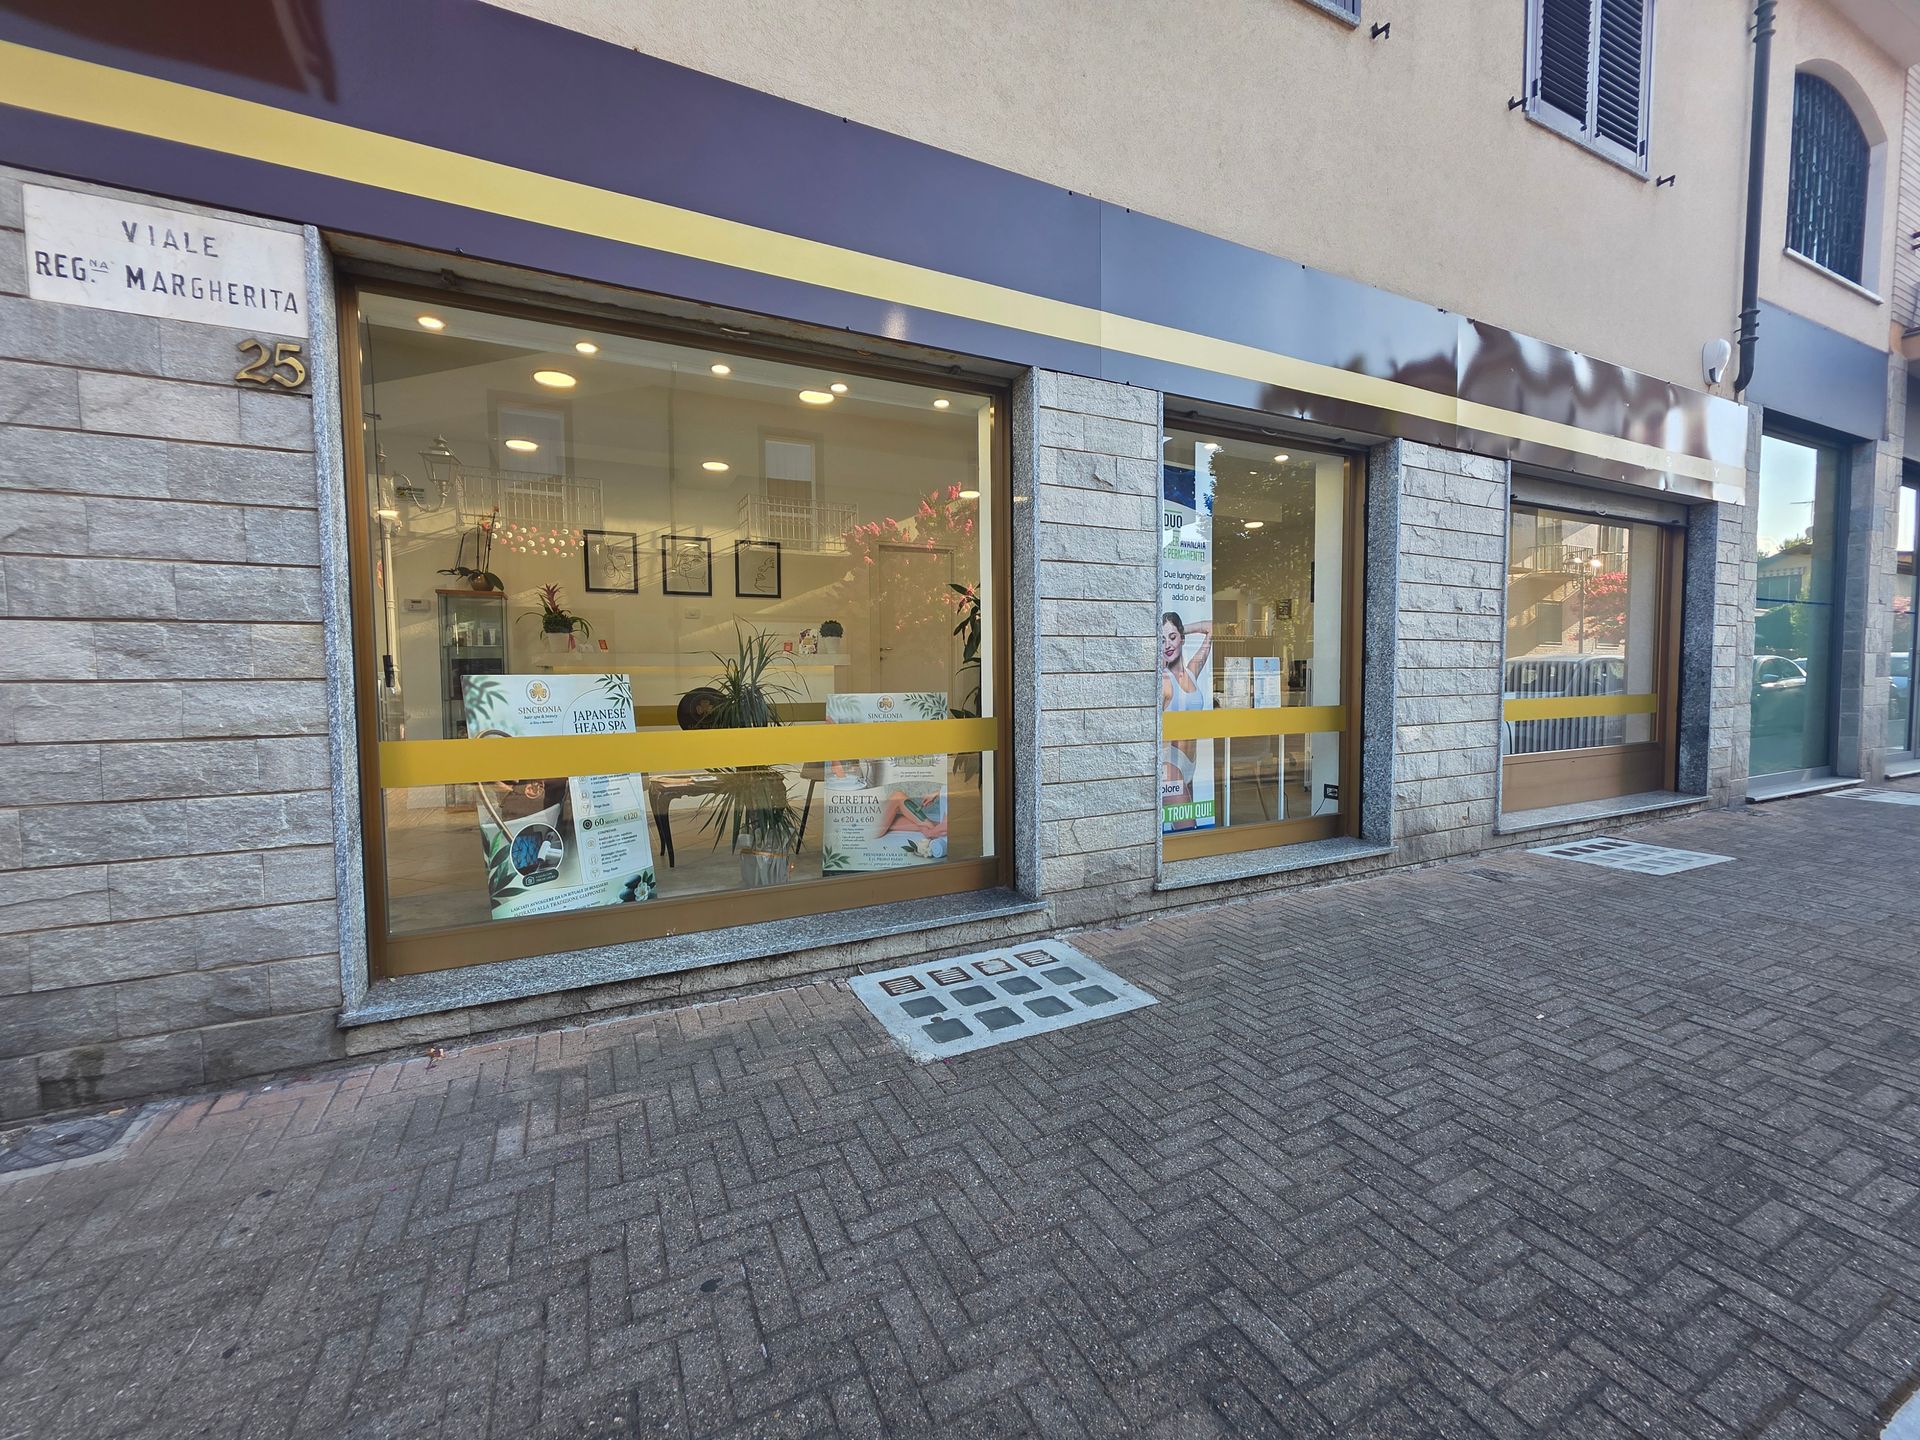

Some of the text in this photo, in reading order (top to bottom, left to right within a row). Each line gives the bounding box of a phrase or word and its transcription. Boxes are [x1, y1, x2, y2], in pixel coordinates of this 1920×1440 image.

[121, 219, 219, 258] VIALE
[125, 264, 299, 314] MARGHERITA
[235, 338, 306, 388] 25
[1164, 570, 1206, 581] Due lunghezze
[1163, 582, 1183, 590] d'onda
[1195, 583, 1206, 592] dire
[1171, 593, 1189, 601] addio
[518, 705, 562, 714] SINCRONIA
[573, 708, 627, 723] JAPANESE
[867, 712, 903, 720] SINCRONIA
[574, 720, 627, 734] HEAD SPA
[831, 795, 880, 805] CERETTA
[828, 805, 882, 814] BRASILIANA
[1167, 804, 1193, 822] TROVI
[1195, 801, 1212, 818] QUI!
[594, 817, 605, 827] 60
[840, 815, 854, 823] €20
[860, 815, 875, 823] €60
[510, 903, 530, 913] LASCIATI
[530, 896, 554, 908] AVVOLGERE
[550, 895, 579, 908] TRADIZIONE
